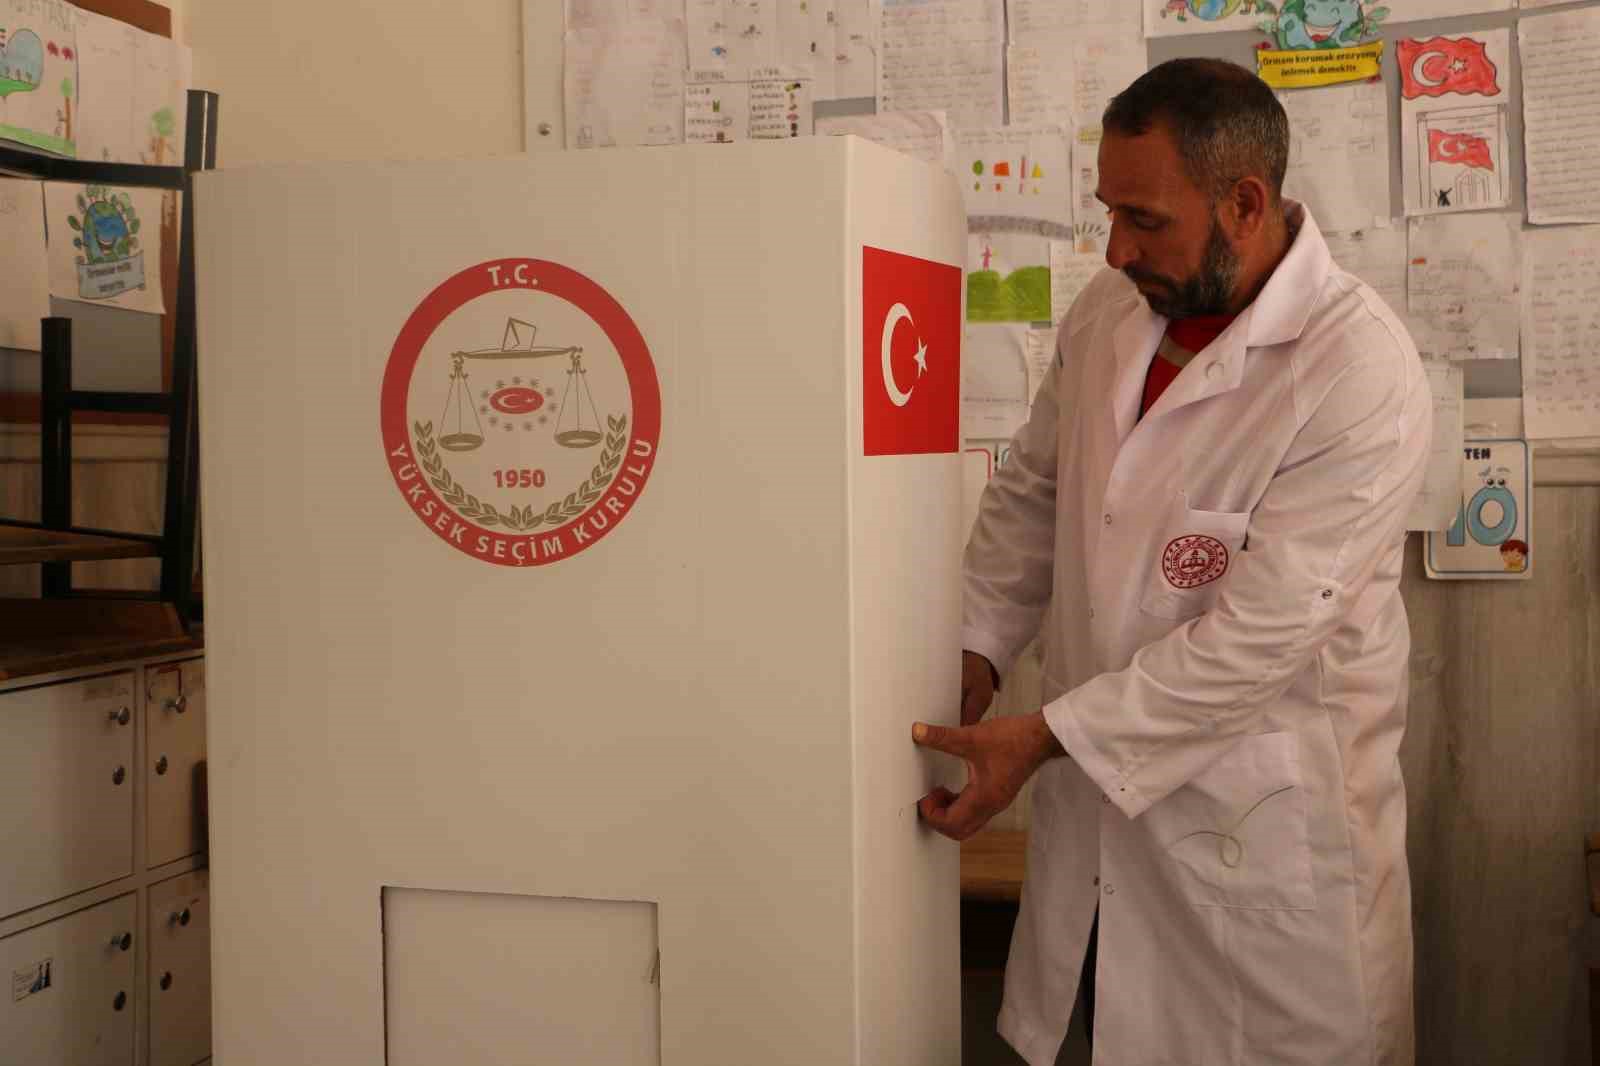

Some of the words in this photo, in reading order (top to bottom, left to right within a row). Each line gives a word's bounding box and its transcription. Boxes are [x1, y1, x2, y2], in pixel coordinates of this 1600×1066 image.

[487, 264, 539, 286] T.C.
[1463, 448, 1491, 460] TEN
[492, 469, 546, 489] 1950
[391, 444, 468, 543] YÜKSEK
[475, 535, 564, 566] SEÇİM
[572, 439, 652, 544] KURULU
